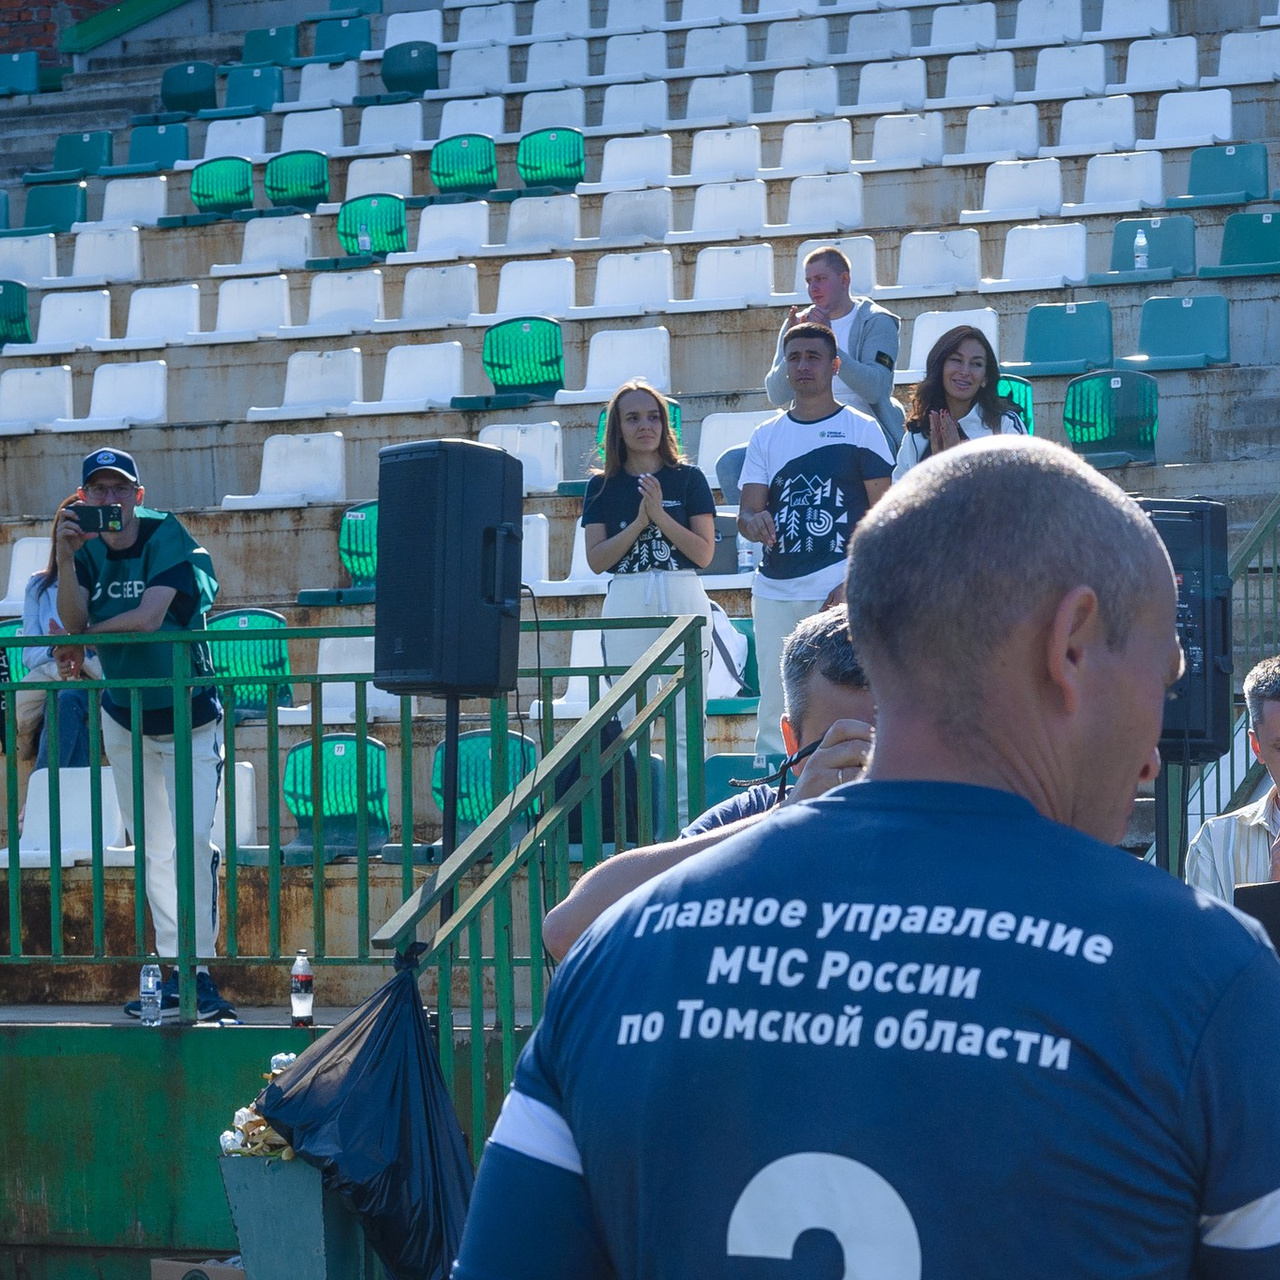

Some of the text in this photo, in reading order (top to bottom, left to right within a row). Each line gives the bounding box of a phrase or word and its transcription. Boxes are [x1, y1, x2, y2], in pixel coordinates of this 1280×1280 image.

[634, 896, 1114, 965] Главное управление
[706, 946, 981, 999] МЧС России
[617, 1000, 1072, 1070] по Томской области
